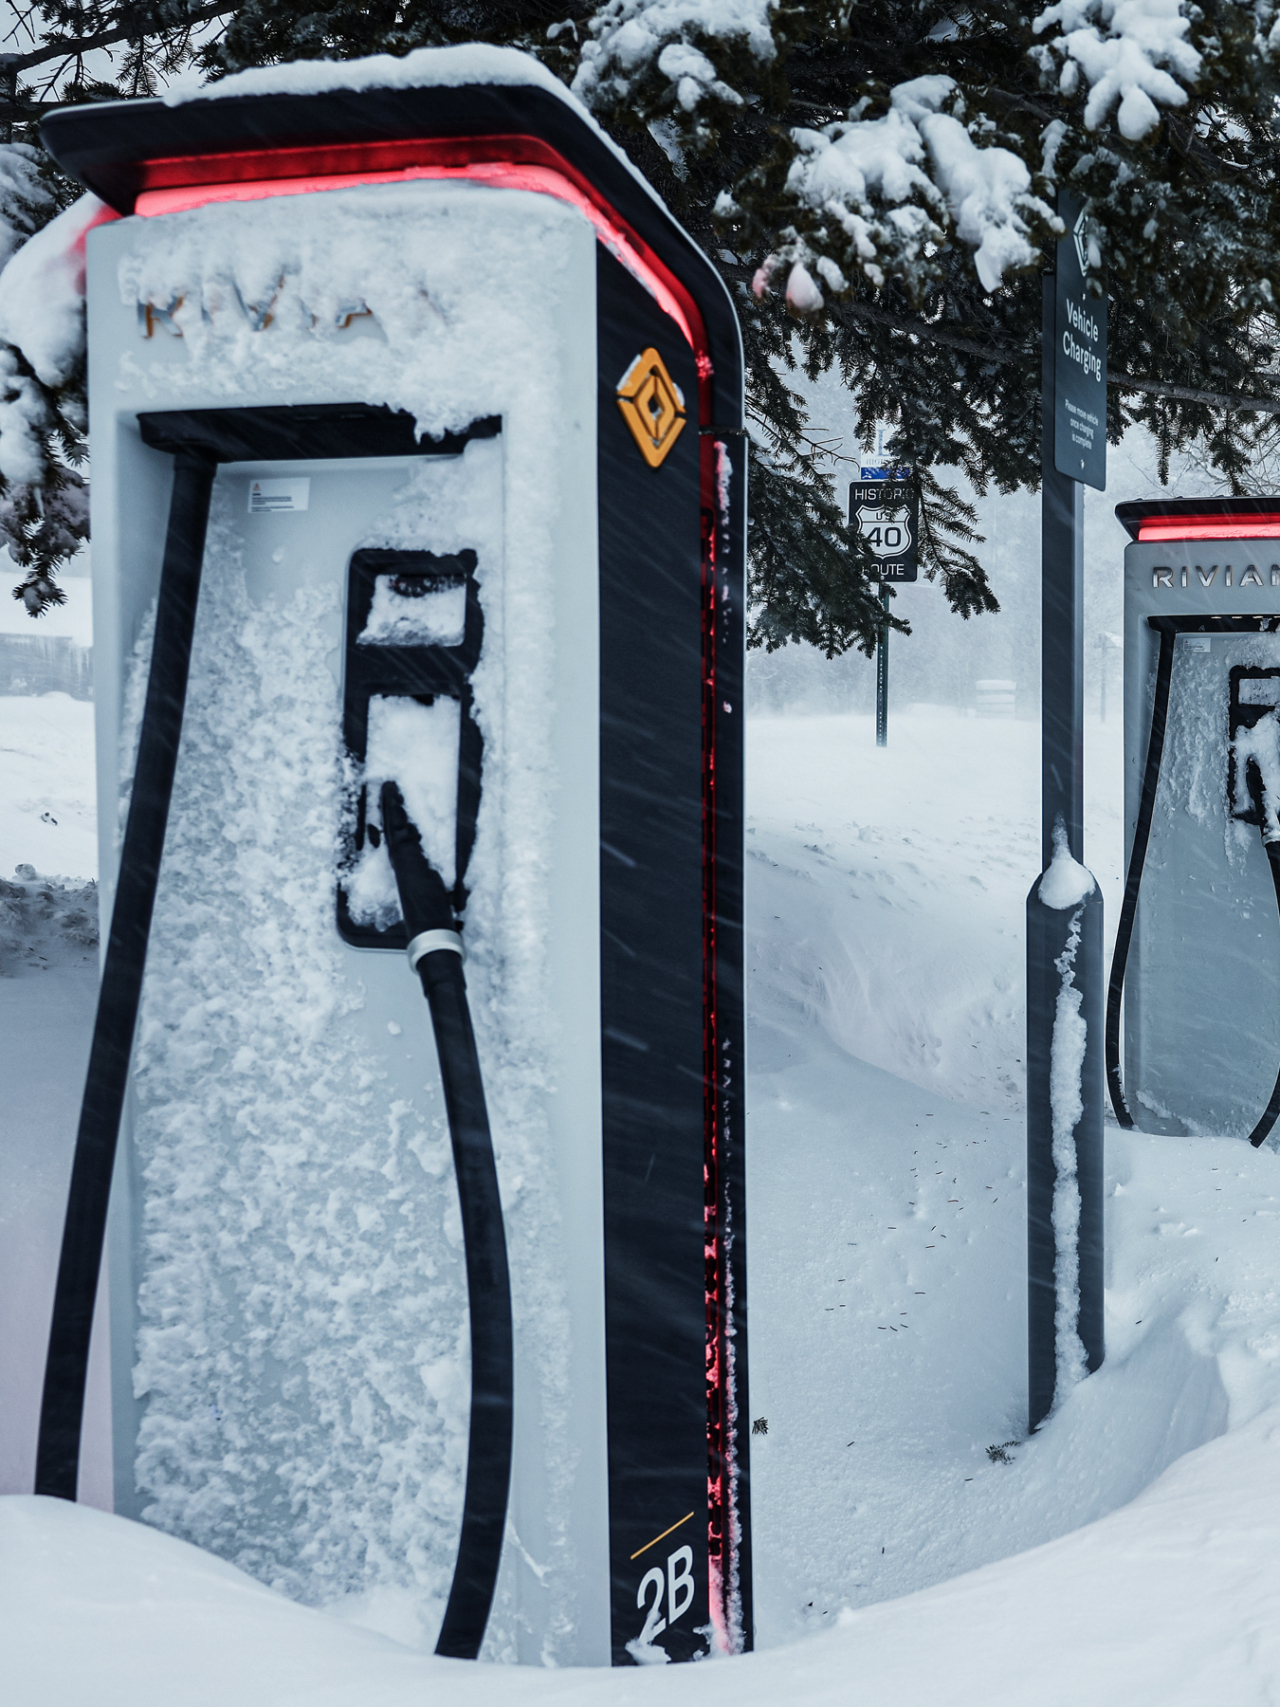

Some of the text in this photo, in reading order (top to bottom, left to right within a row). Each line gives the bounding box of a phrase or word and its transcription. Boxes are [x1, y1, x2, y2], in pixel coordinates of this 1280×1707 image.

[1066, 298, 1099, 342] Vehicle
[1063, 331, 1102, 382] Charging
[865, 526, 902, 547] 40
[862, 563, 905, 576] OUTE
[636, 1544, 695, 1648] 2B
